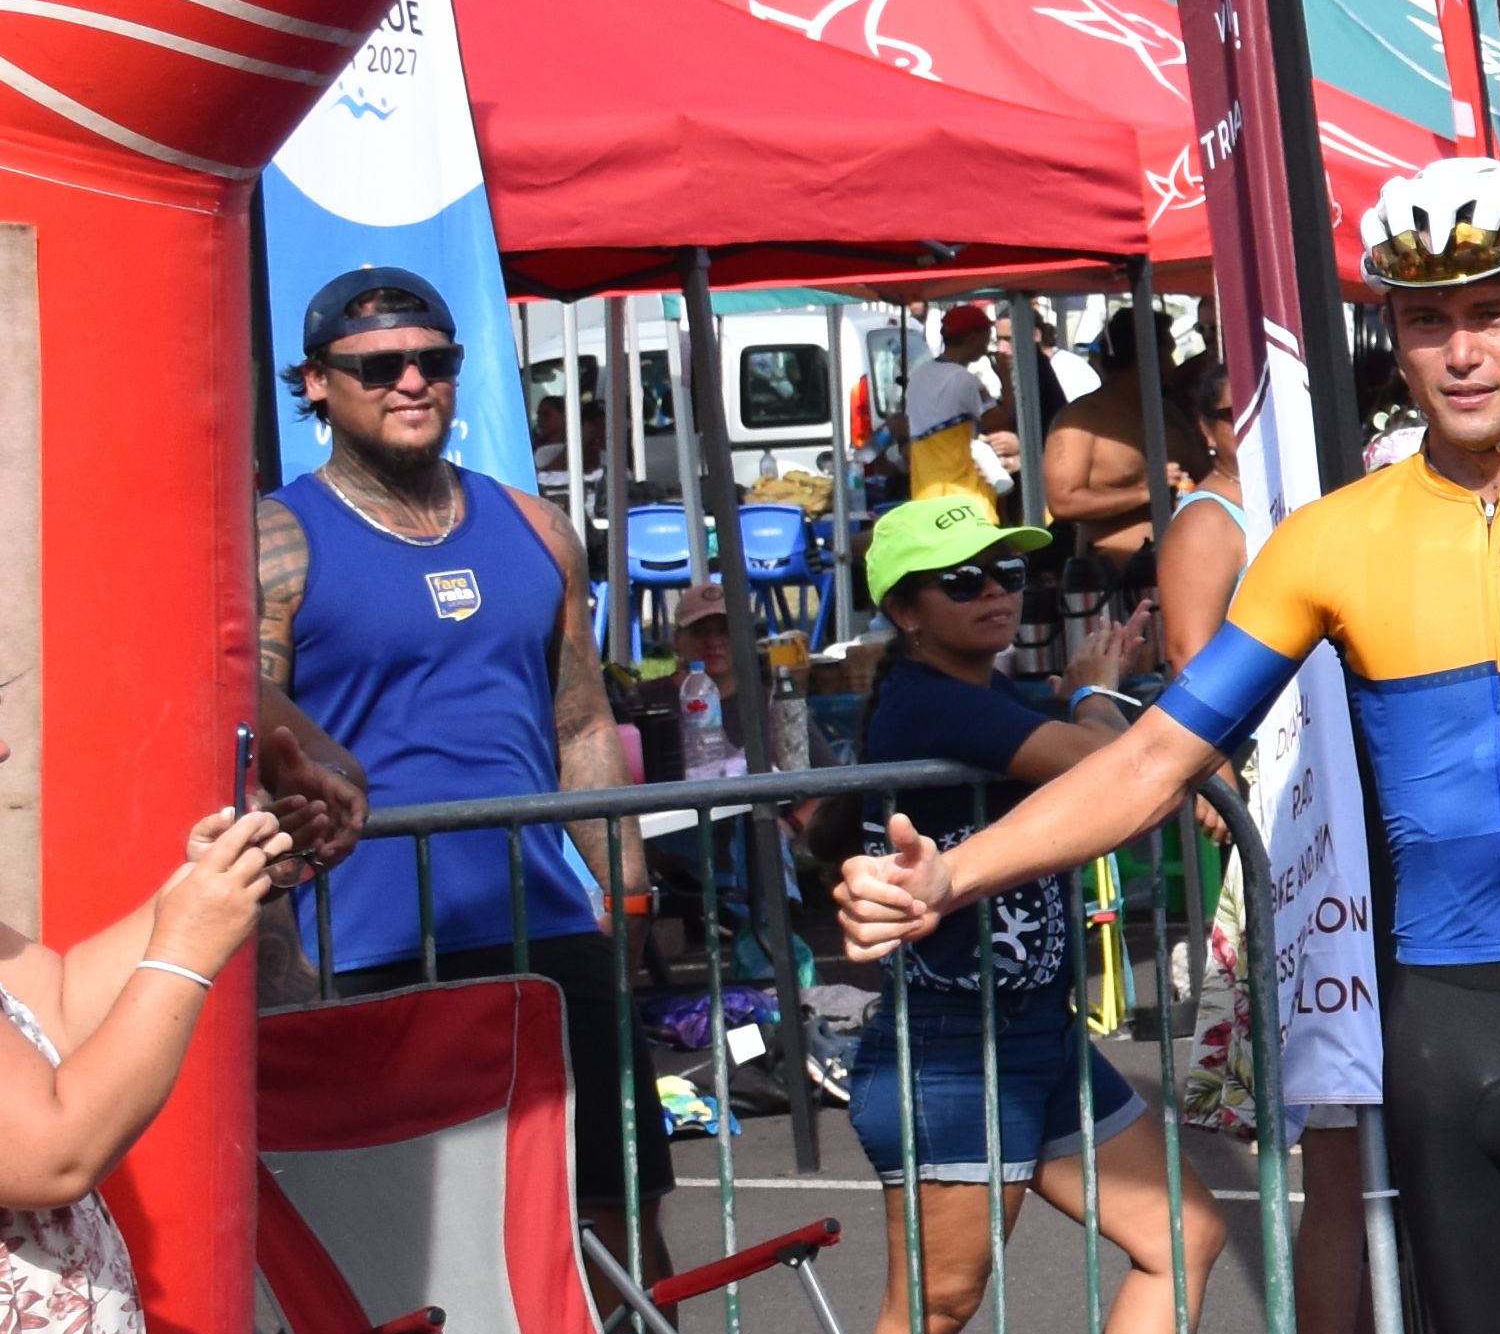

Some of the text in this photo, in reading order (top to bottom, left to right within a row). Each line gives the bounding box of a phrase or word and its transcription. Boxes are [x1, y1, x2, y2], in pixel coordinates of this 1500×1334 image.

[366, 44, 417, 77] 2027
[935, 505, 975, 530] EDT
[438, 587, 475, 603] rata
